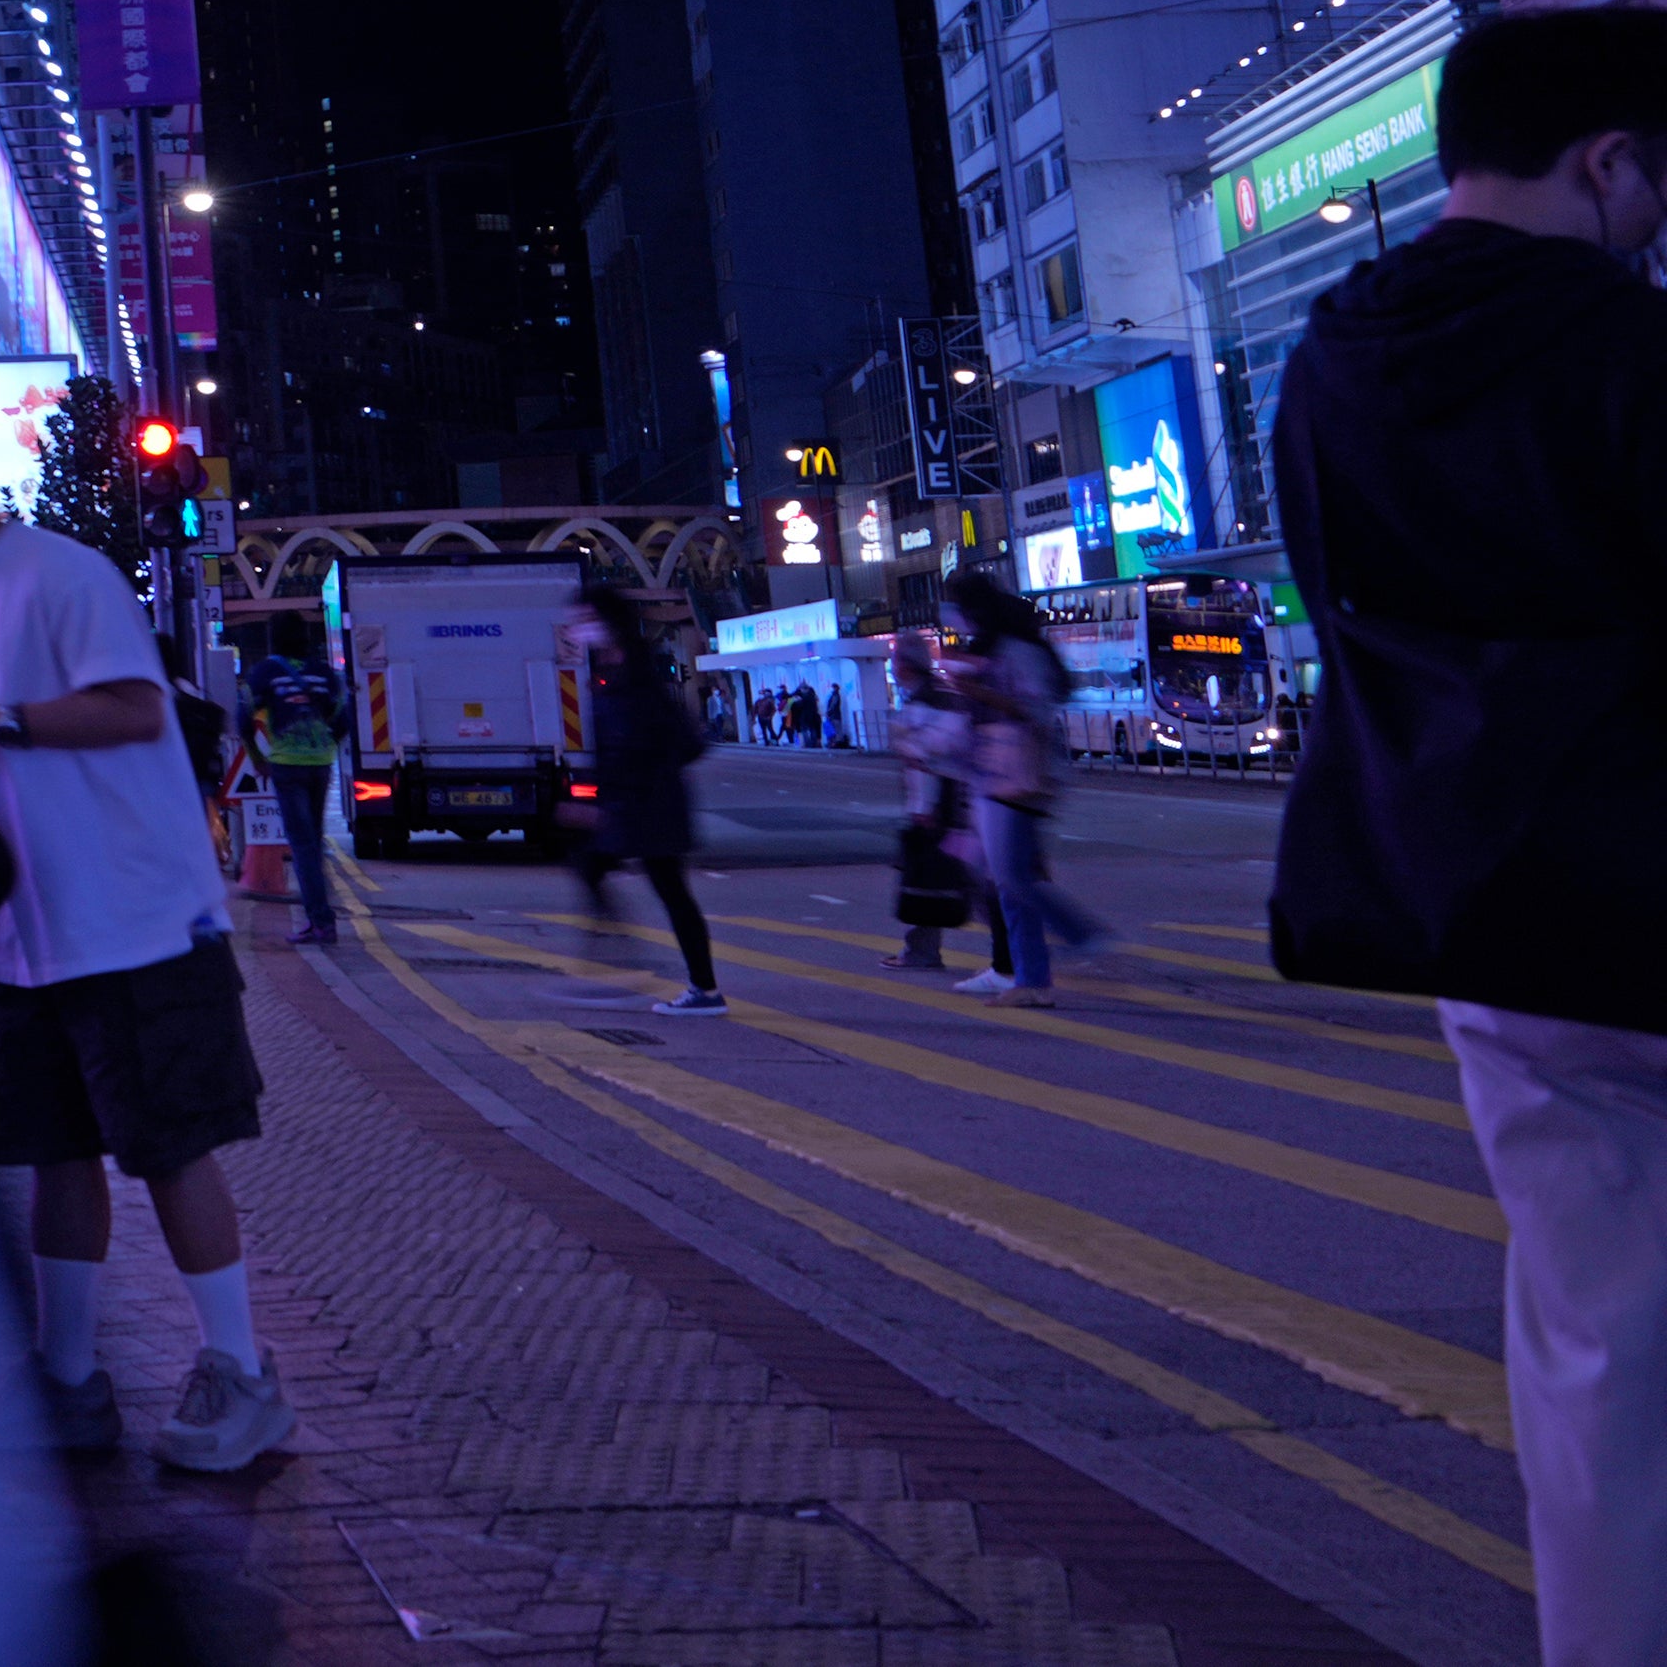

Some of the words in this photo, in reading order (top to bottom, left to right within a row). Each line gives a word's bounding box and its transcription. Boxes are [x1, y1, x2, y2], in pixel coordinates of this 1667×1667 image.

[1320, 129, 1355, 181] HANG
[1354, 116, 1388, 162] SENG
[1387, 103, 1427, 150] BANK
[917, 364, 952, 488] LIVE
[430, 624, 503, 638] BRINKS
